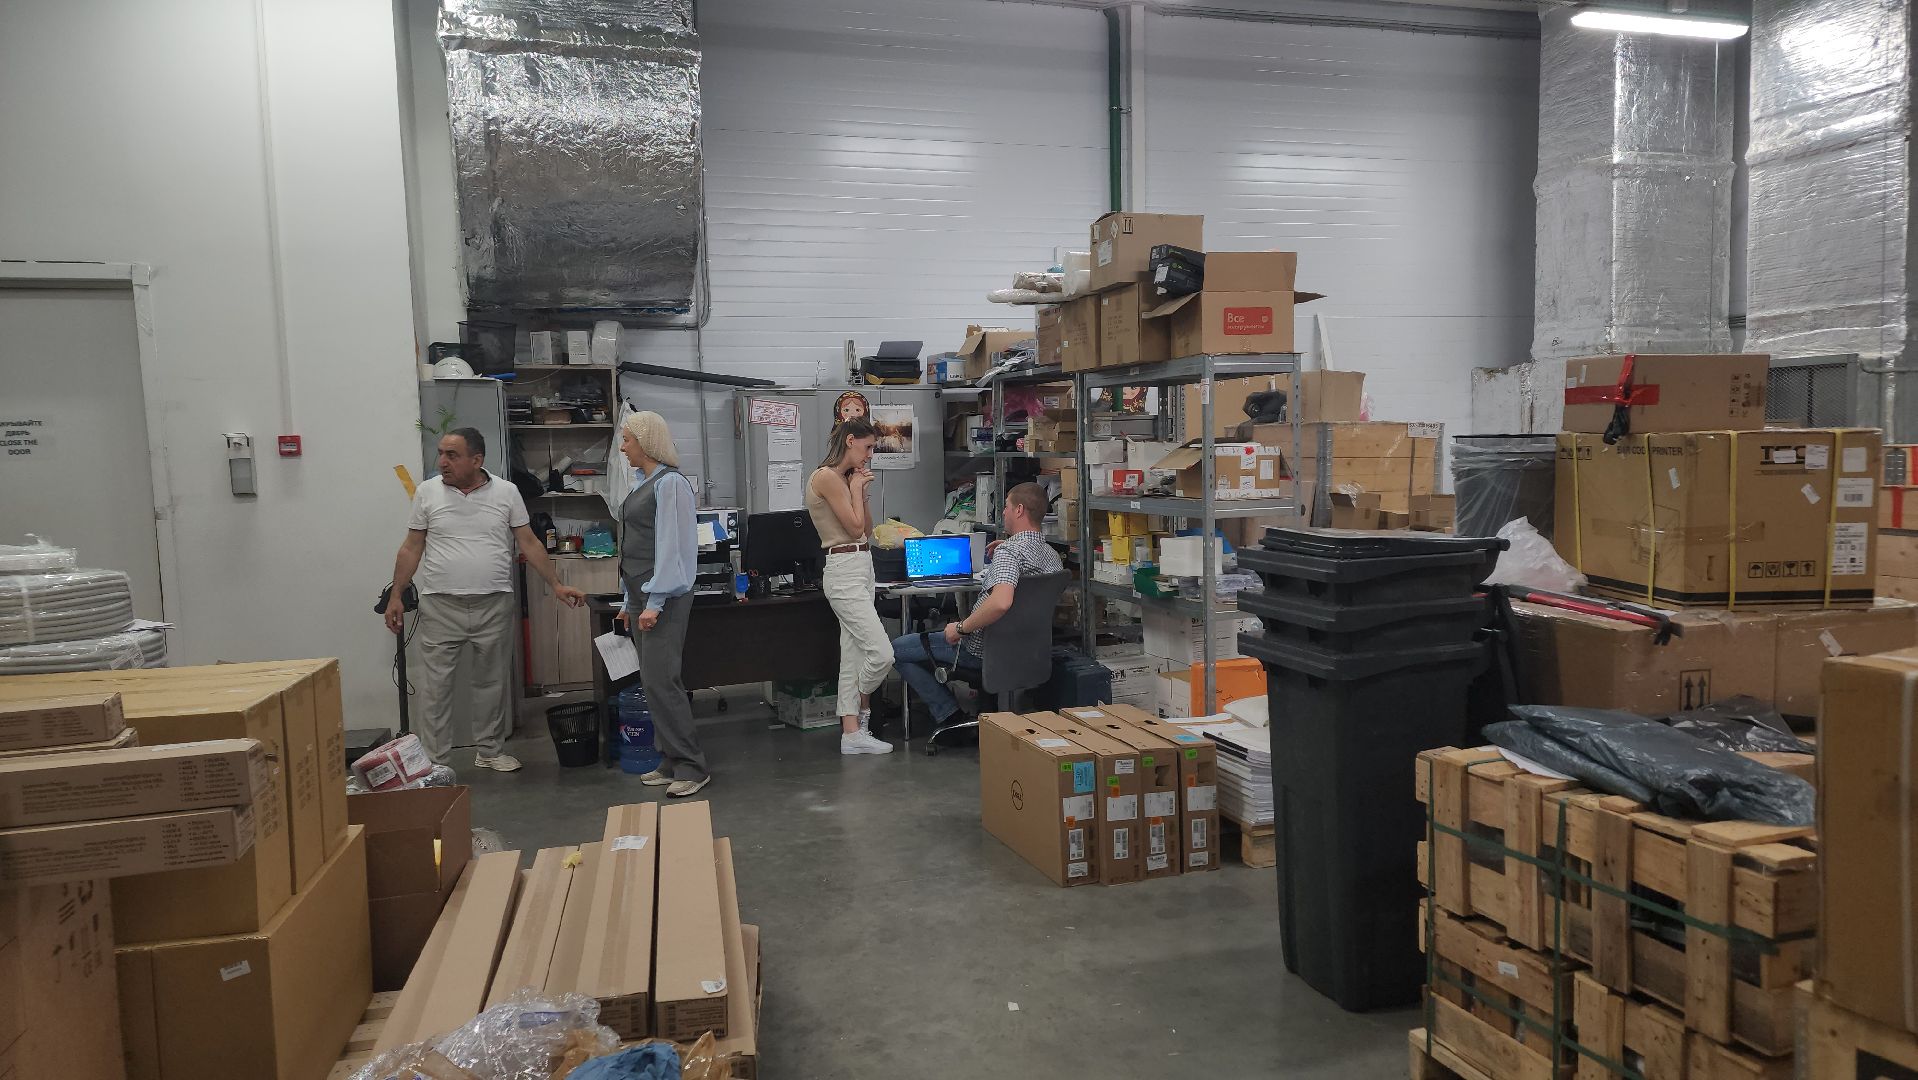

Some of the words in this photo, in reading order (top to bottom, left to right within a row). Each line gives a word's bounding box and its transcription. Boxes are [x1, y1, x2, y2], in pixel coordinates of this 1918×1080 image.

[1227, 313, 1245, 323] Все
[0, 439, 22, 447] CLOSE
[23, 438, 38, 446] THE
[8, 448, 31, 456] DOOR
[1652, 446, 1684, 456] PRINTER
